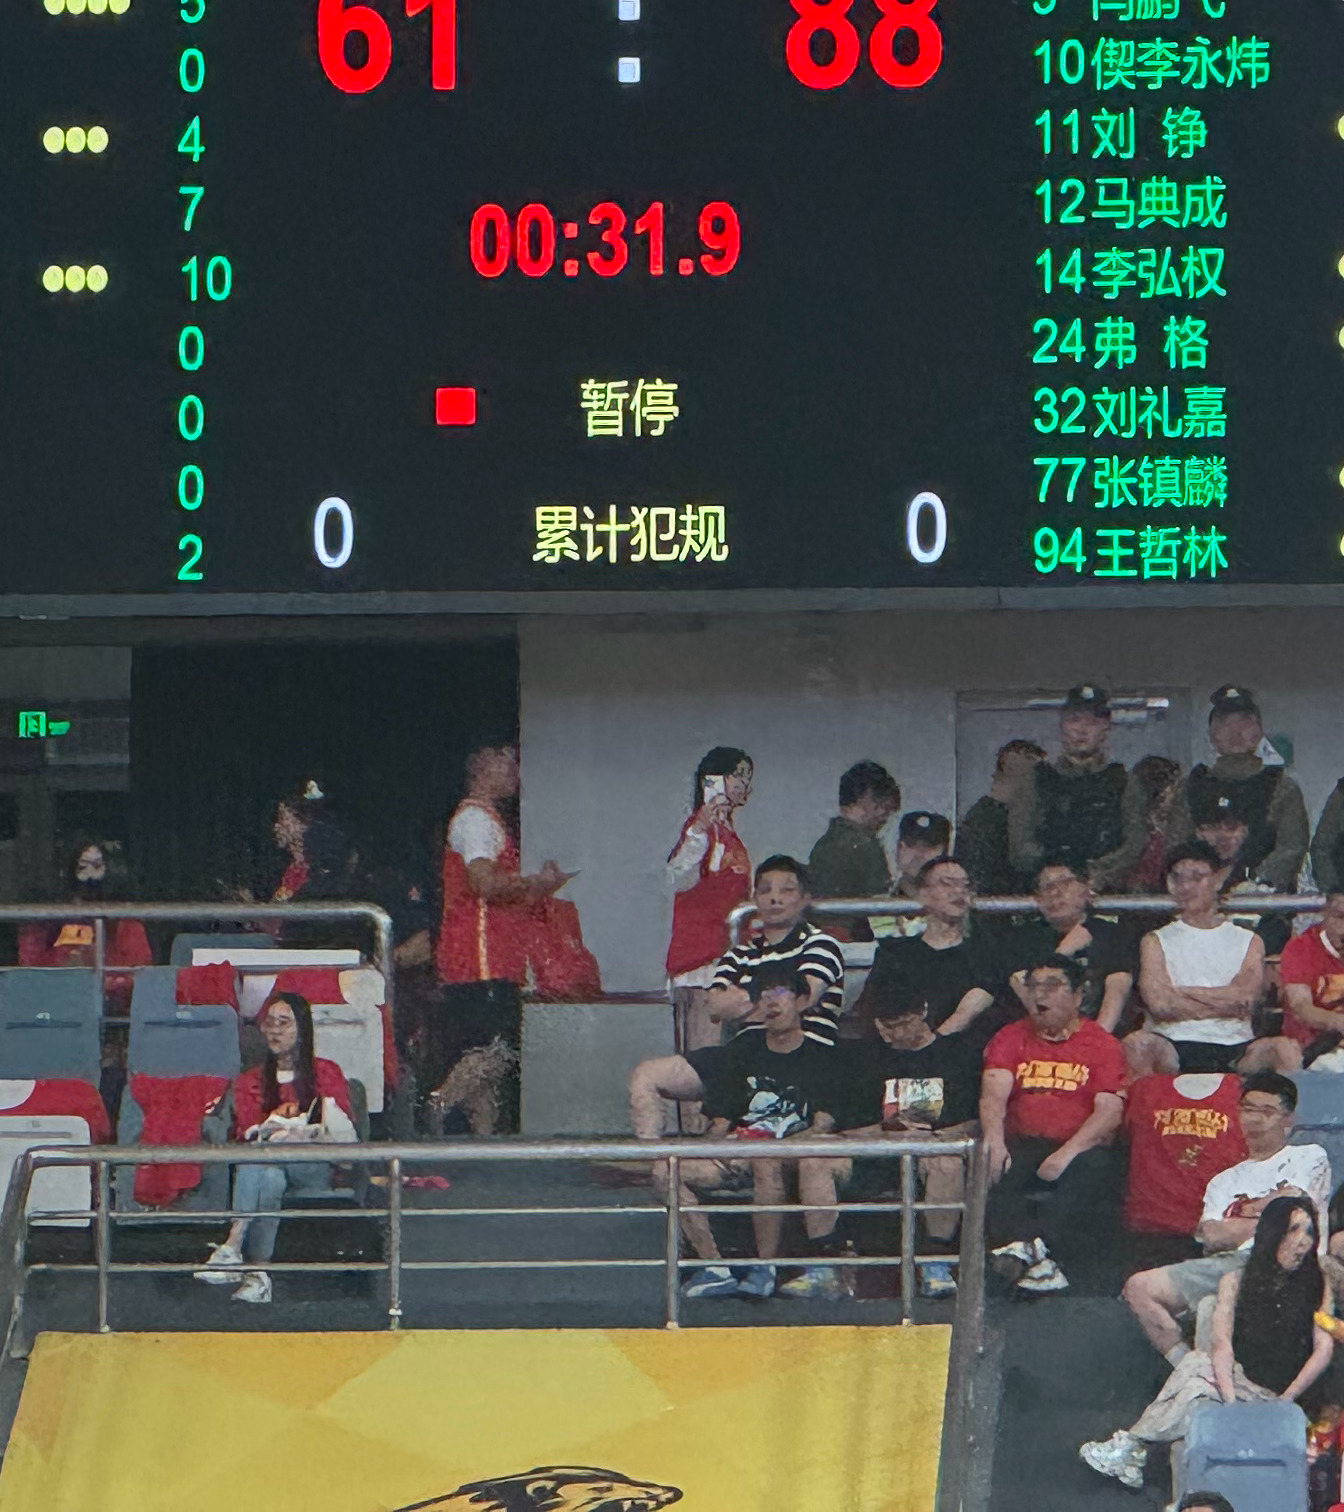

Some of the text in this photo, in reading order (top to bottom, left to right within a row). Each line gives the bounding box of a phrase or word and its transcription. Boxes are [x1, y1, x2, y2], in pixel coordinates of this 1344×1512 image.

[180, 48, 205, 92] 0
[178, 116, 205, 162] 4
[179, 186, 204, 231] 7
[1092, 176, 1227, 229] 马典成
[470, 202, 743, 279] 00:31.9
[182, 256, 231, 301] 10
[1092, 246, 1226, 299] 李弘权
[179, 326, 204, 370] 0
[179, 395, 204, 440] 0
[581, 378, 681, 439] 暂停
[1092, 386, 1227, 439] 刘礼嘉
[178, 465, 204, 510] 0
[314, 492, 948, 570] 0 累计犯规 0
[1094, 525, 1228, 580] 王哲林
[178, 534, 203, 580] 2
